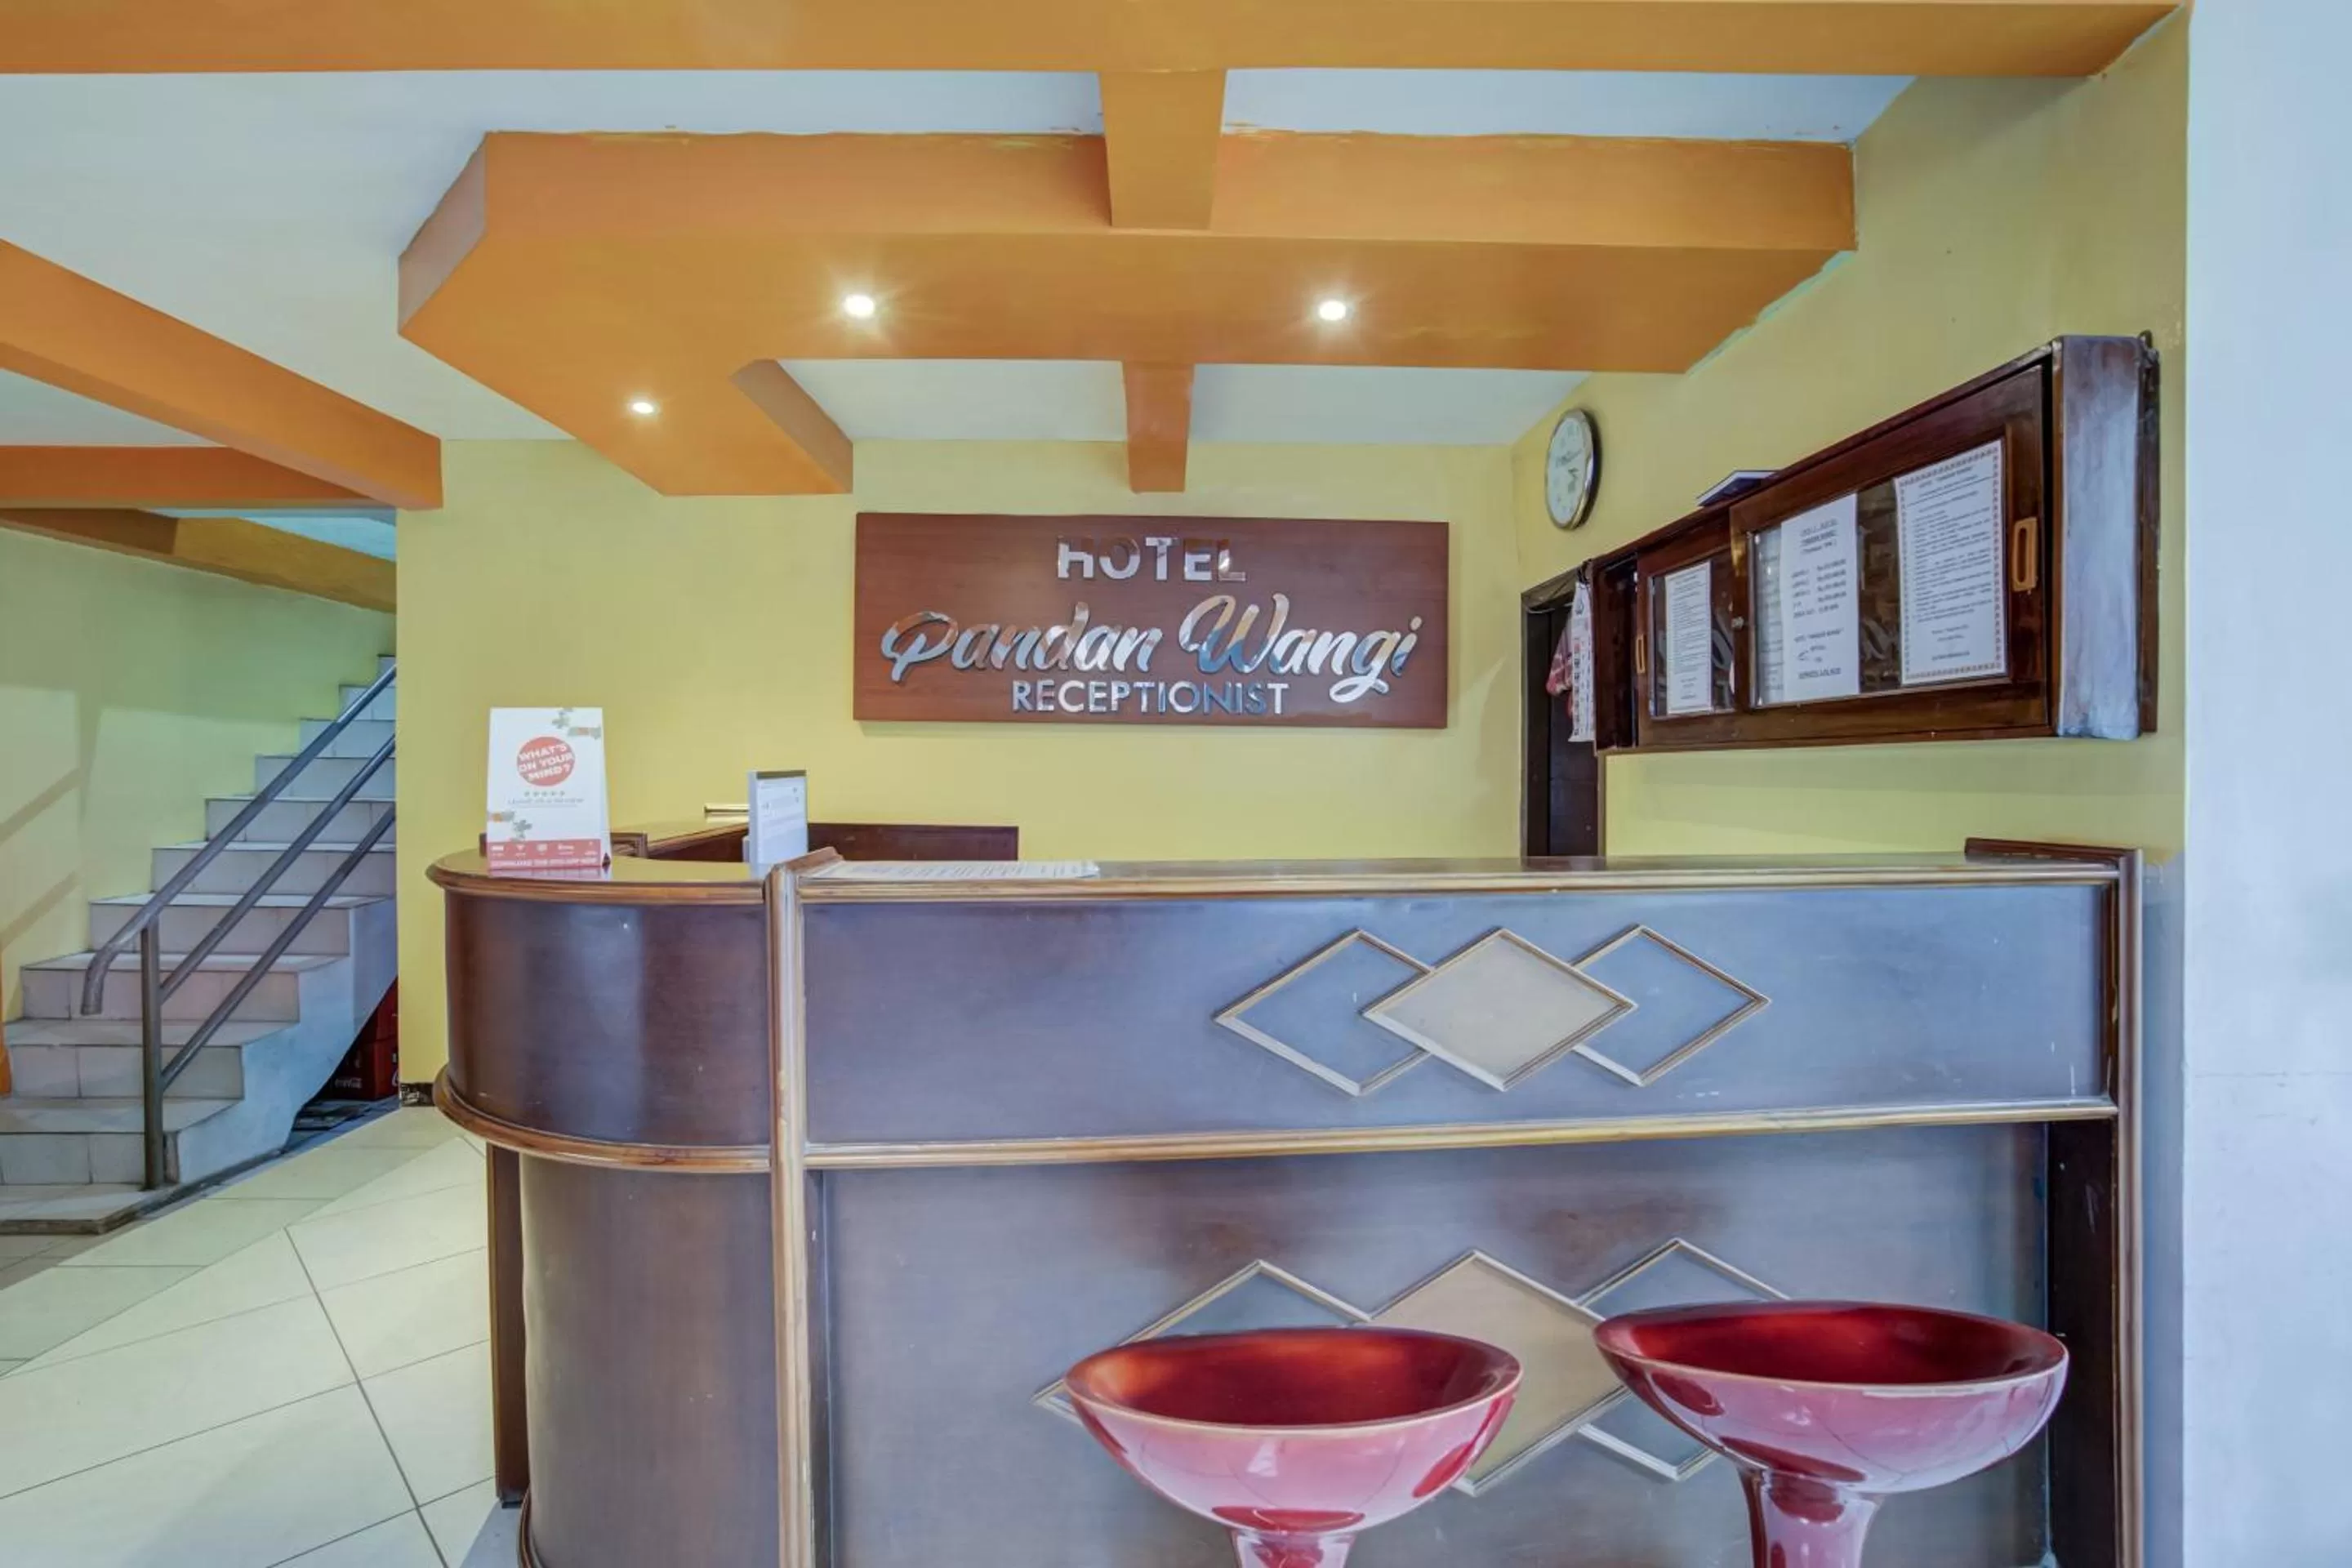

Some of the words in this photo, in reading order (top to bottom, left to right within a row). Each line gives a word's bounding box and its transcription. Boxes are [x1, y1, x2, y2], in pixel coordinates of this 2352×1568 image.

[1057, 537, 1247, 582] HOTEL
[881, 603, 1164, 684] Pandan
[1178, 594, 1423, 704] Wangi
[1011, 679, 1290, 715] RECEPTIONIST
[519, 761, 537, 773] ON
[539, 753, 573, 767] YOUR
